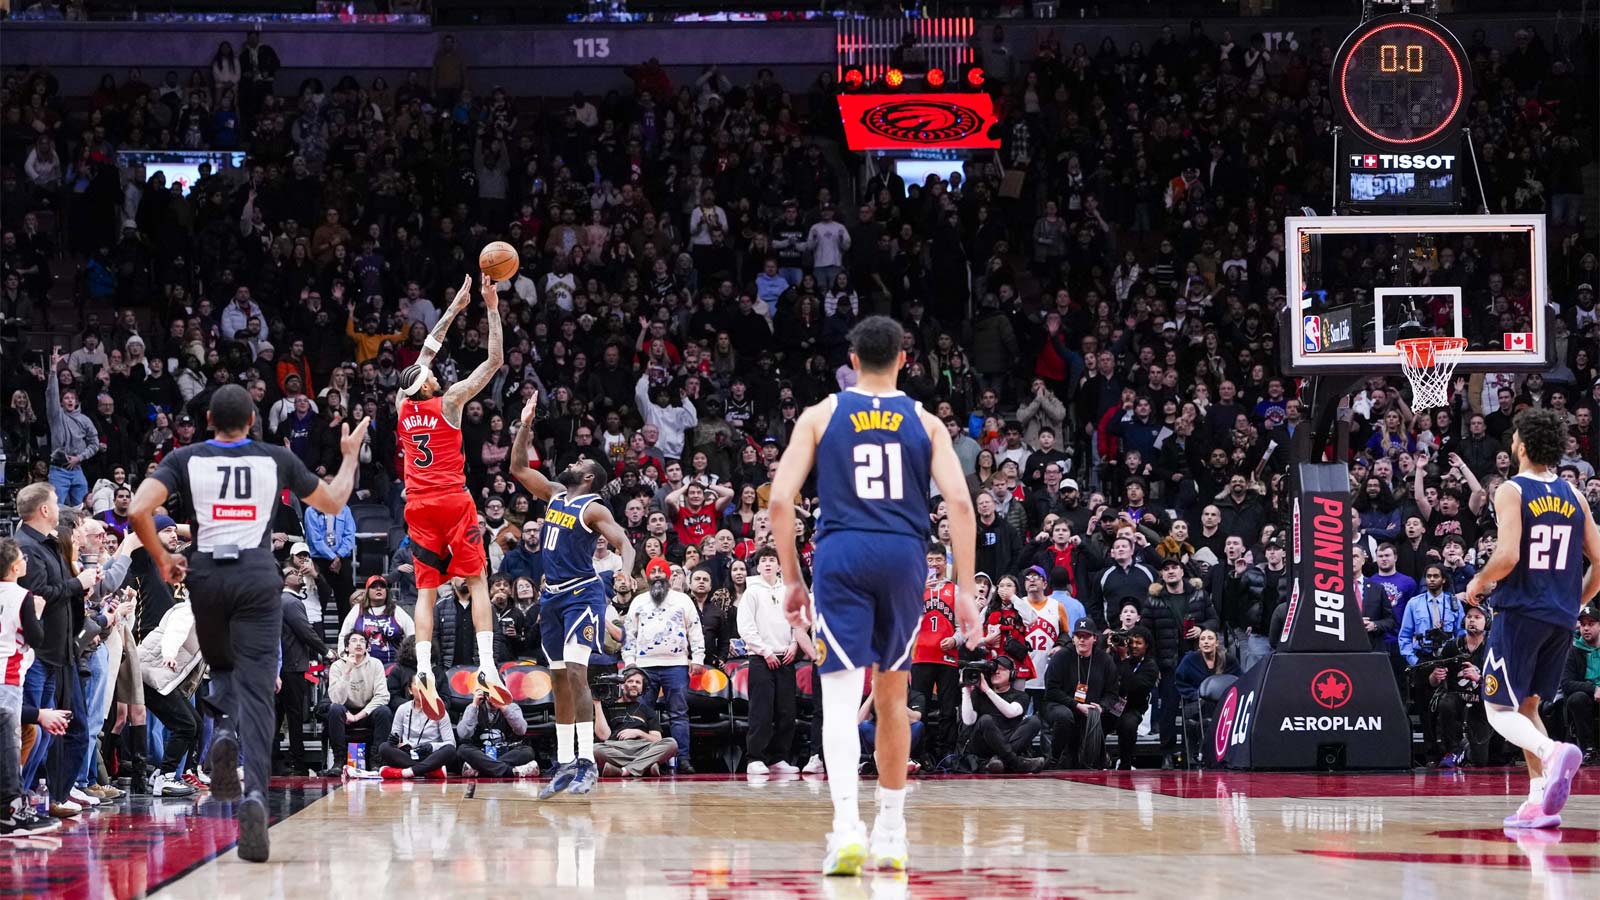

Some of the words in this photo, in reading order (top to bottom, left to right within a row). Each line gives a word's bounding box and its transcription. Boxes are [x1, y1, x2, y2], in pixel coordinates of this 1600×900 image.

[573, 38, 610, 58] 113
[1380, 45, 1423, 72] 0.0
[1379, 155, 1455, 169] TISSOT
[402, 414, 439, 431] INGRAM
[849, 411, 904, 433] JONES
[412, 433, 434, 468] 3
[217, 466, 252, 500] 70
[853, 443, 904, 500] 21
[215, 507, 254, 518] Emirates
[1527, 495, 1575, 519] MURRAY
[543, 526, 560, 552] 10
[1528, 524, 1572, 570] 27
[1313, 496, 1345, 642] POINTSBET
[930, 616, 938, 633] 1
[1030, 635, 1048, 651] 12
[1231, 690, 1254, 746] LG
[1280, 716, 1382, 731] AEROPLAN
